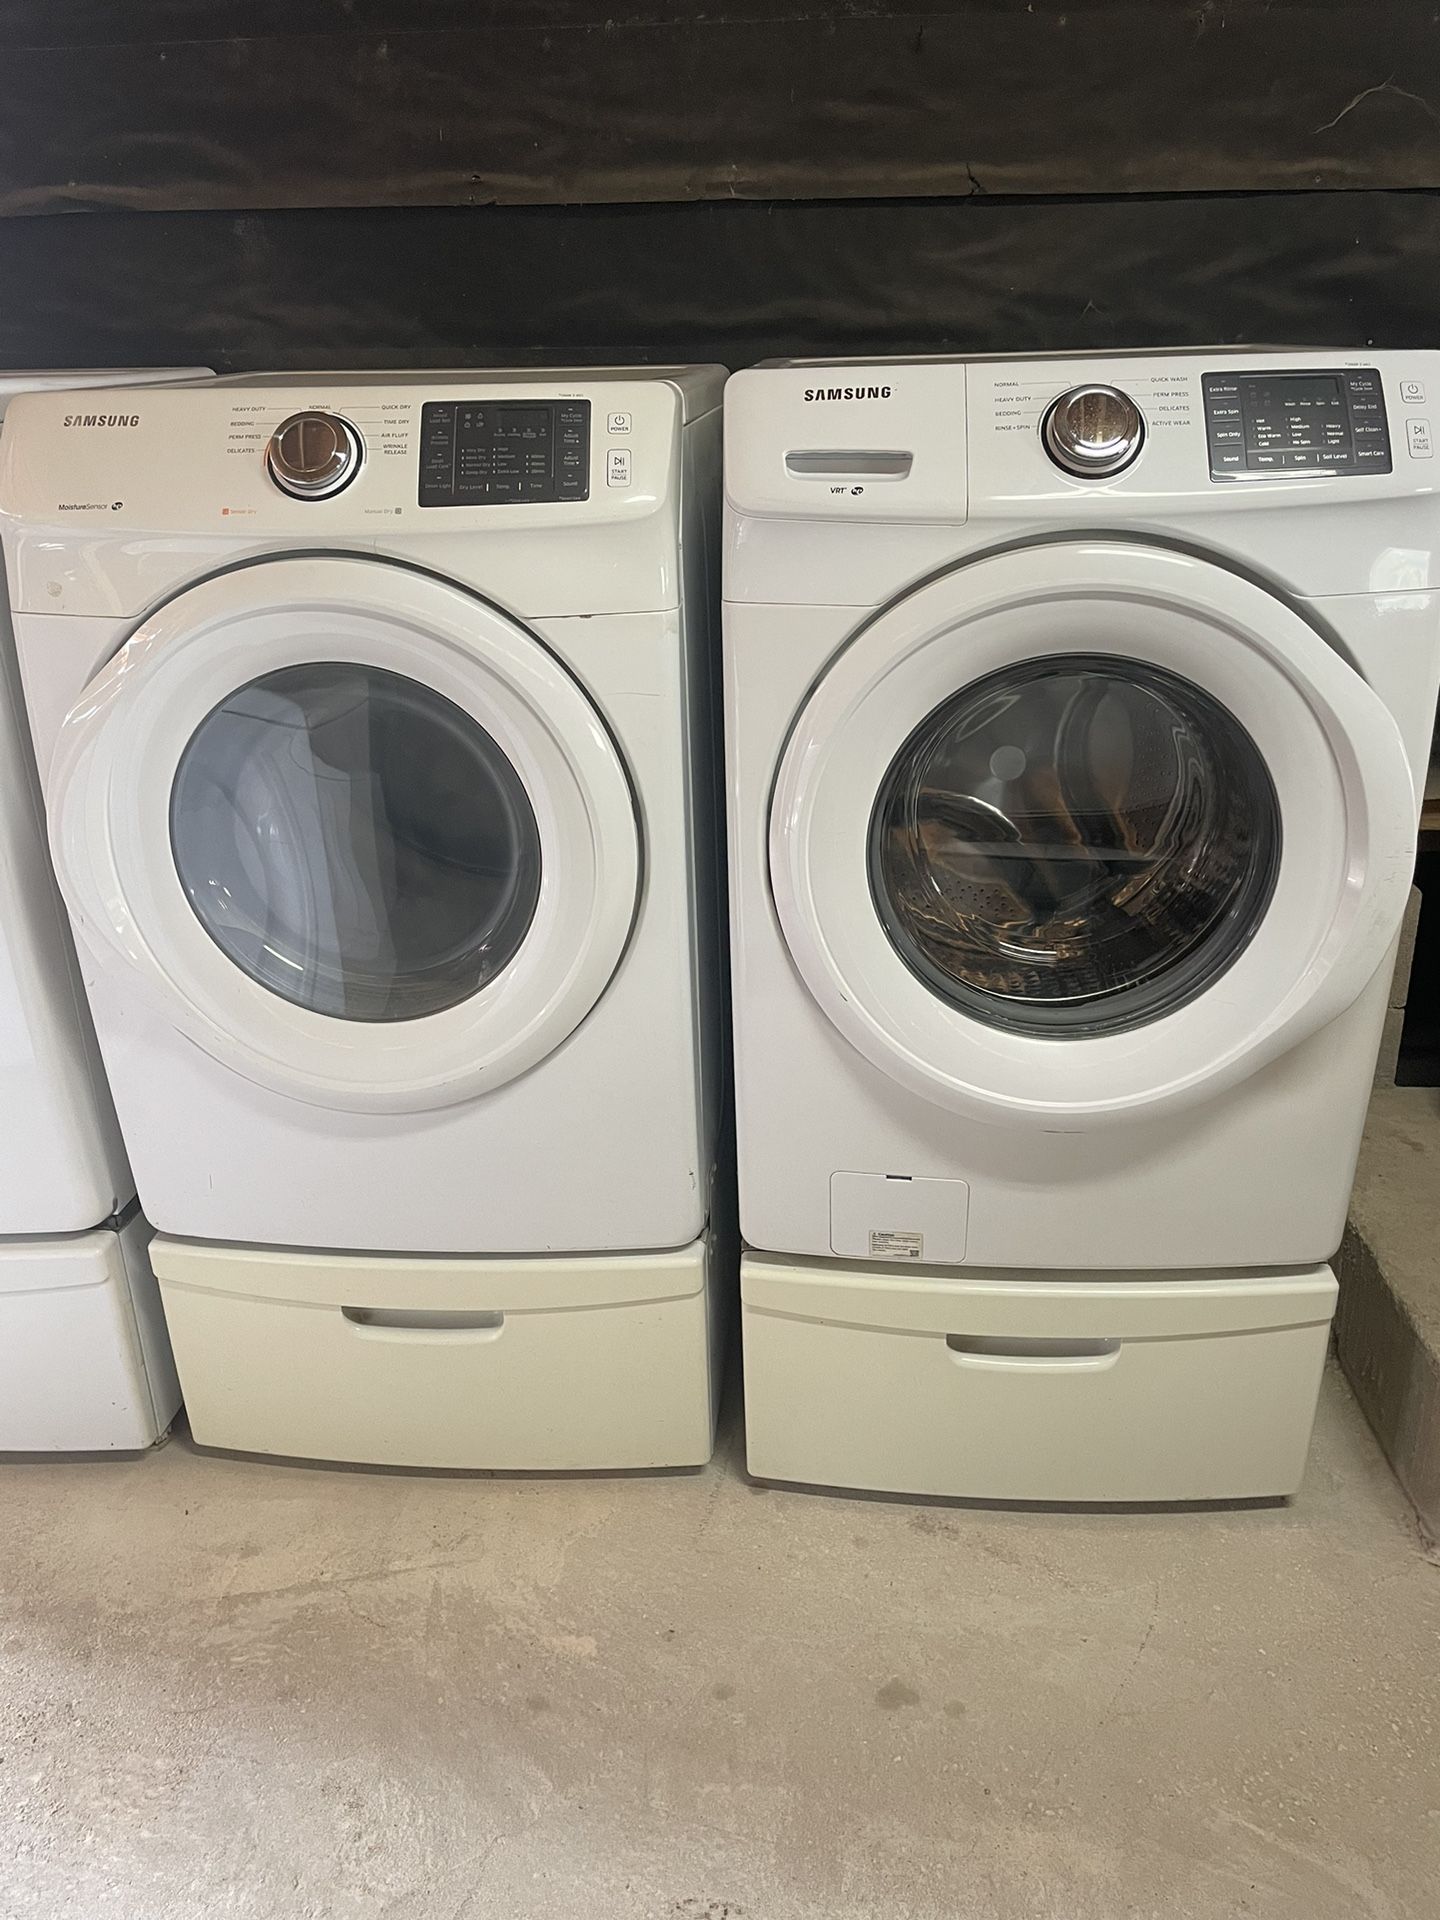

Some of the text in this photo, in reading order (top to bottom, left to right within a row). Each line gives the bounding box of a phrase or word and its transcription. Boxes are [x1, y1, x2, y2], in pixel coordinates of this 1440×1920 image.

[804, 386, 891, 401] SAMSUNG
[63, 414, 140, 428] SAMSUNG
[58, 502, 108, 512] MoistureSensor
